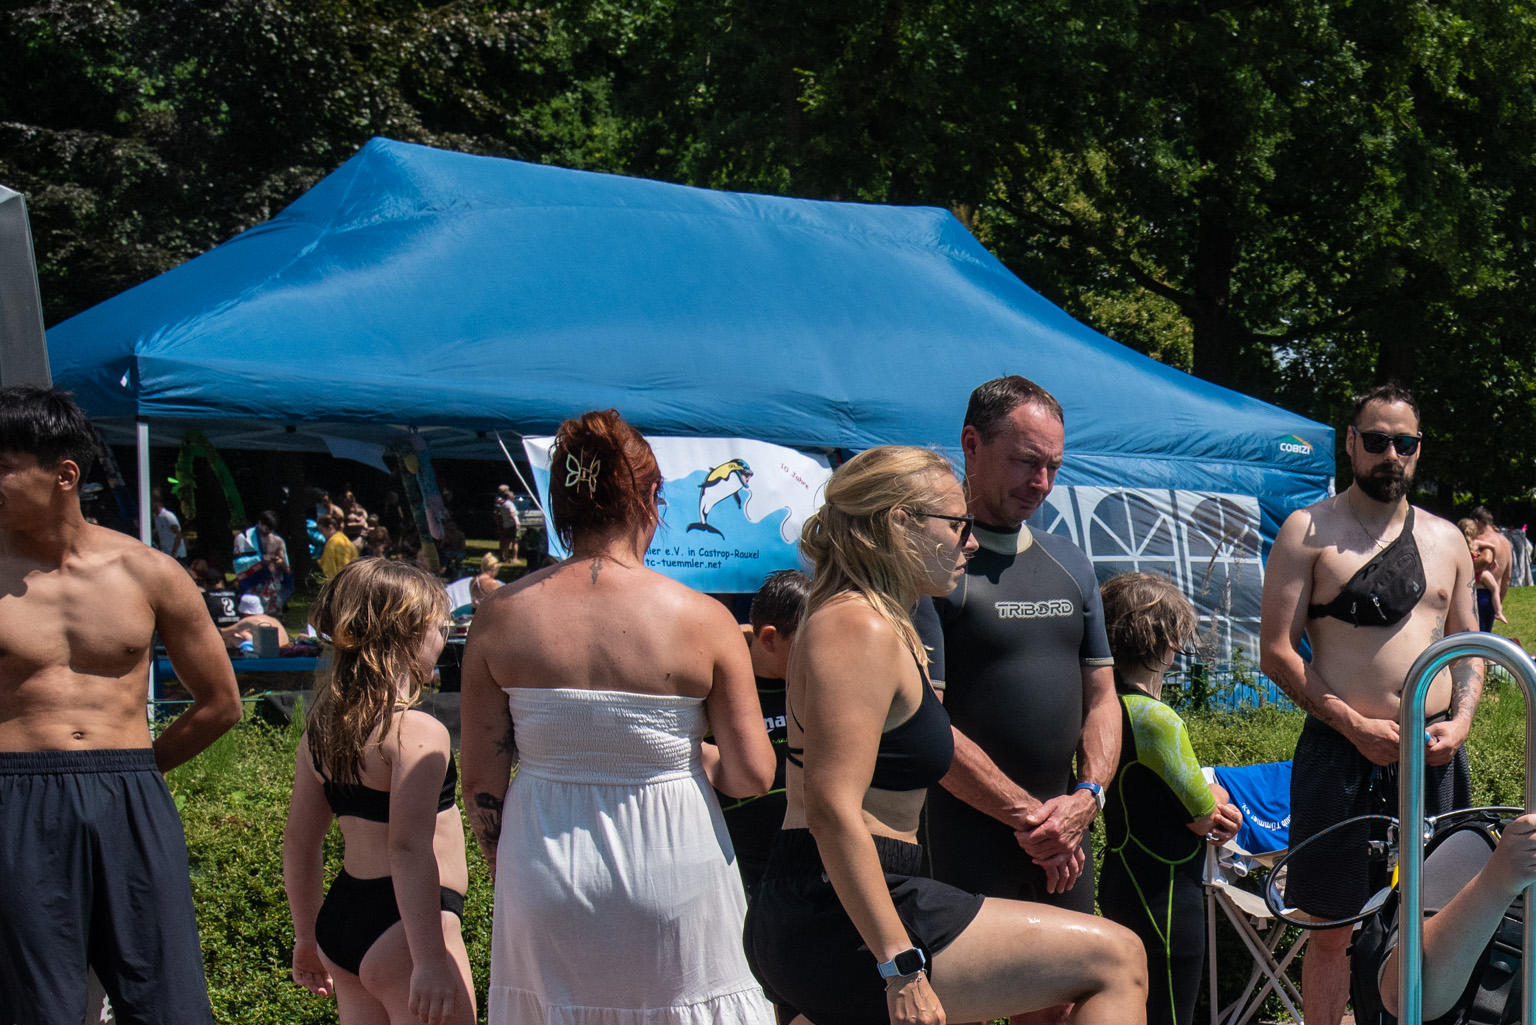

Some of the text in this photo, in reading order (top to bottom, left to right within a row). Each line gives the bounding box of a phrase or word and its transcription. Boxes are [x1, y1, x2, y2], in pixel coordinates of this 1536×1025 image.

[1280, 442, 1311, 455] COBIZI
[665, 546, 684, 557] e.V.
[687, 547, 696, 557] in
[698, 548, 760, 560] Castrop-Rauxel
[645, 558, 722, 569] tc-tuemmler.net
